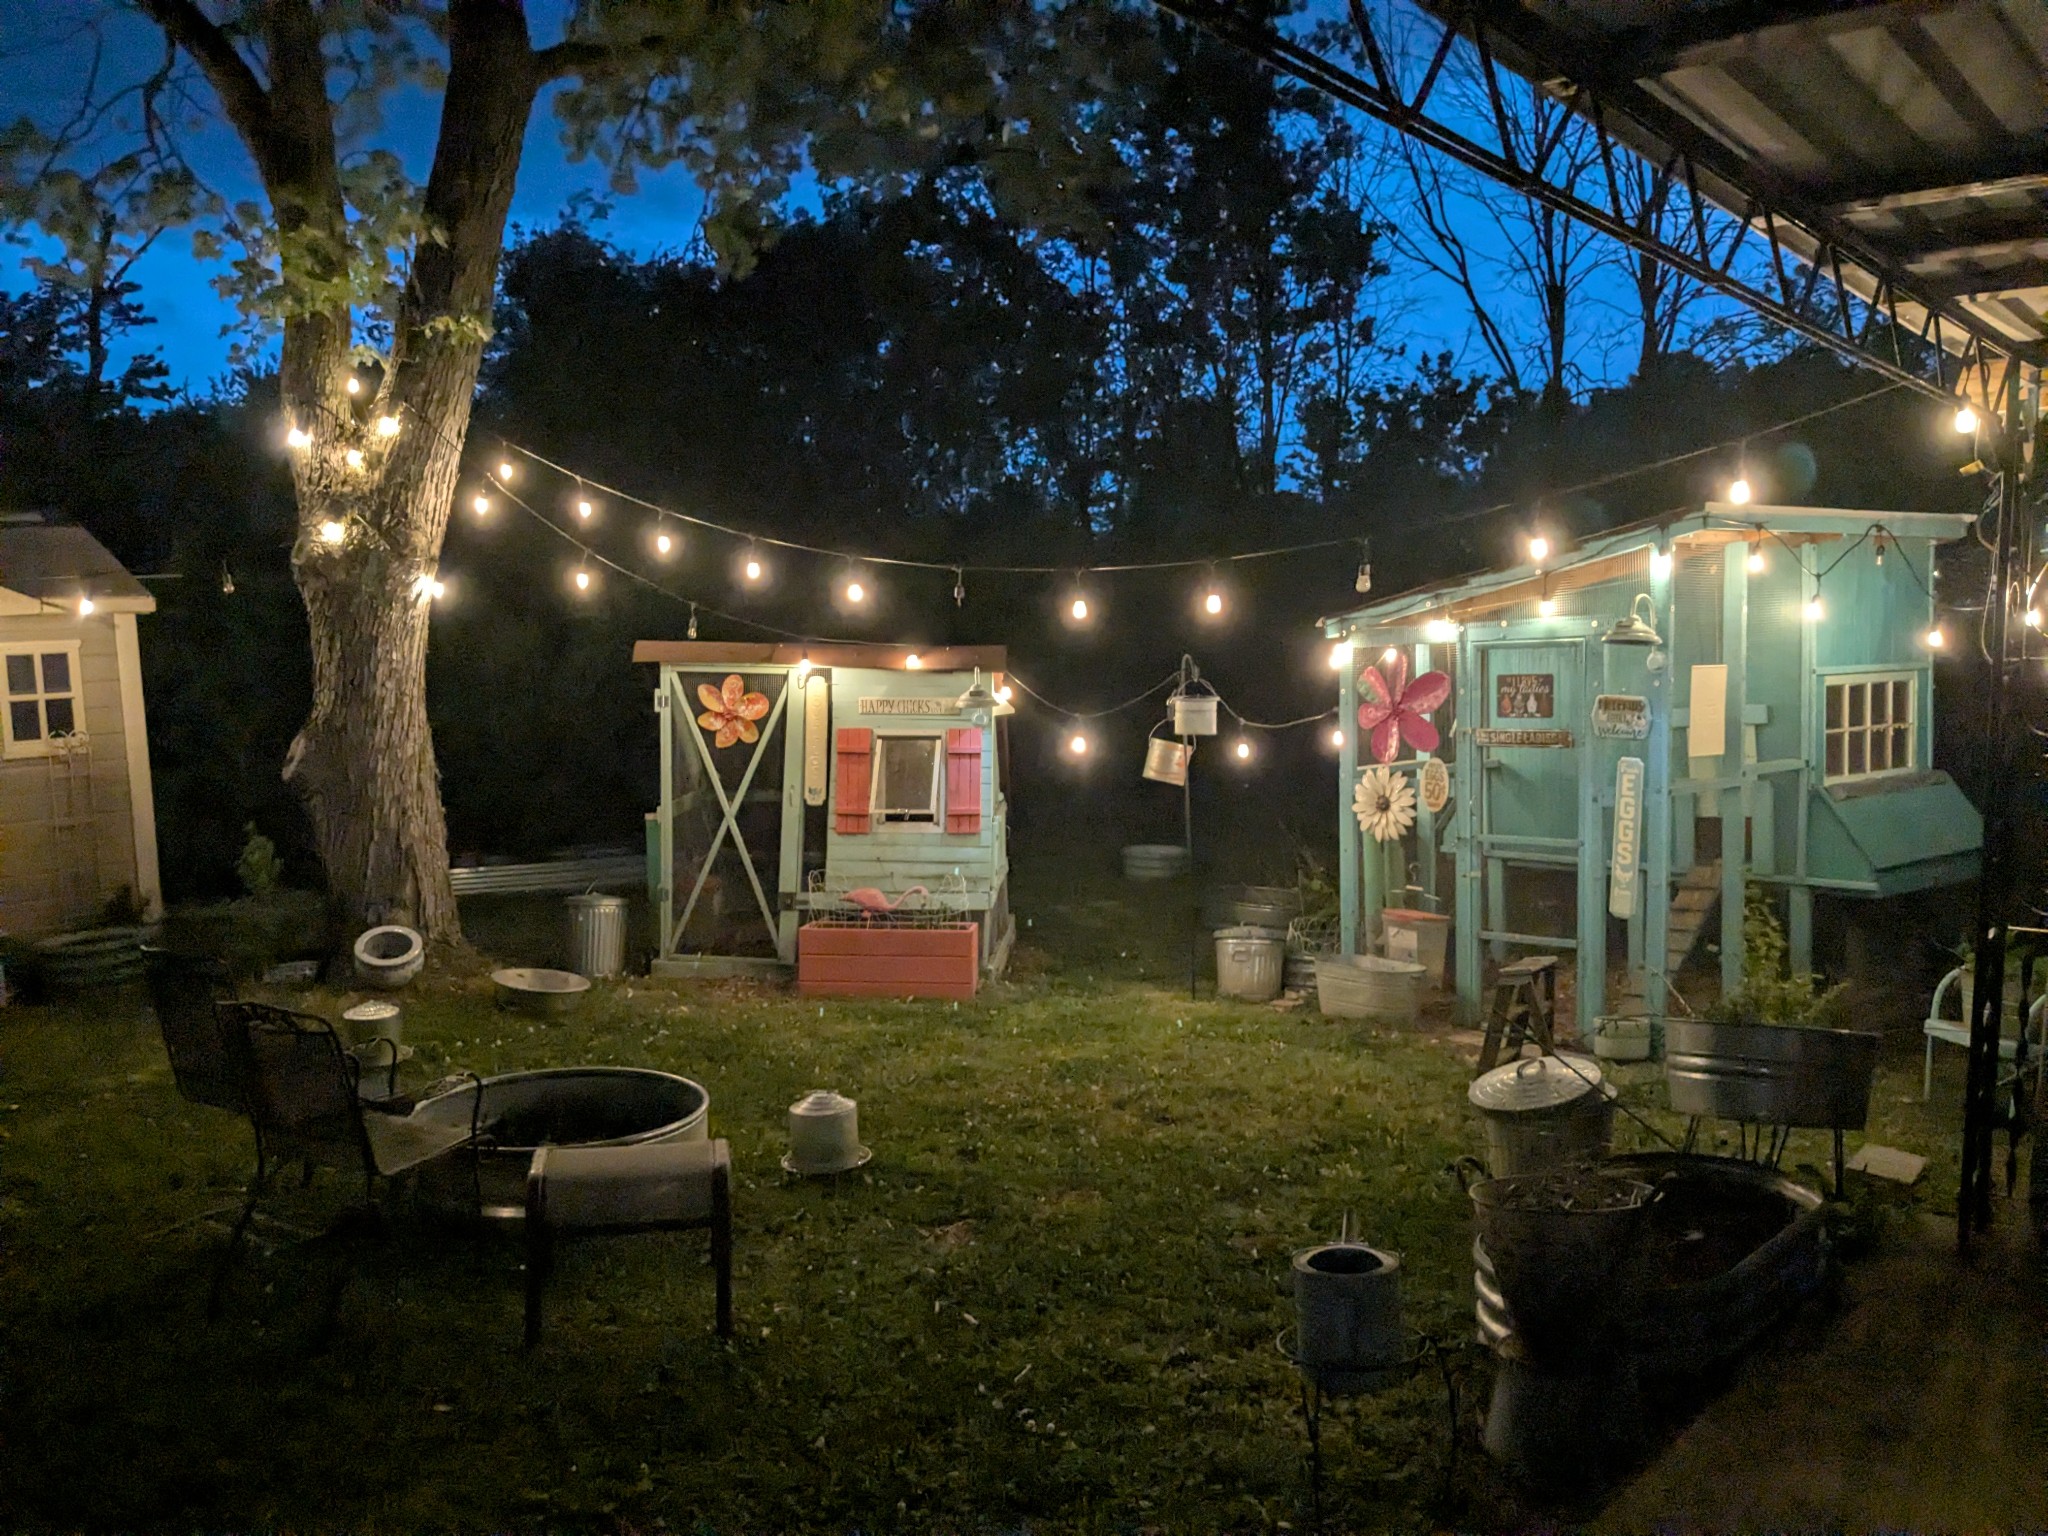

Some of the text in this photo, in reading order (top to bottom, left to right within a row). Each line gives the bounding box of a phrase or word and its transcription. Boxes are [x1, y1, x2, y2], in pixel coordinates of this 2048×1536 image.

[861, 699, 895, 714] HAPPY
[897, 699, 930, 714] CHICKS
[1490, 732, 1522, 744] SINGLE
[1617, 774, 1636, 864] EGGS
